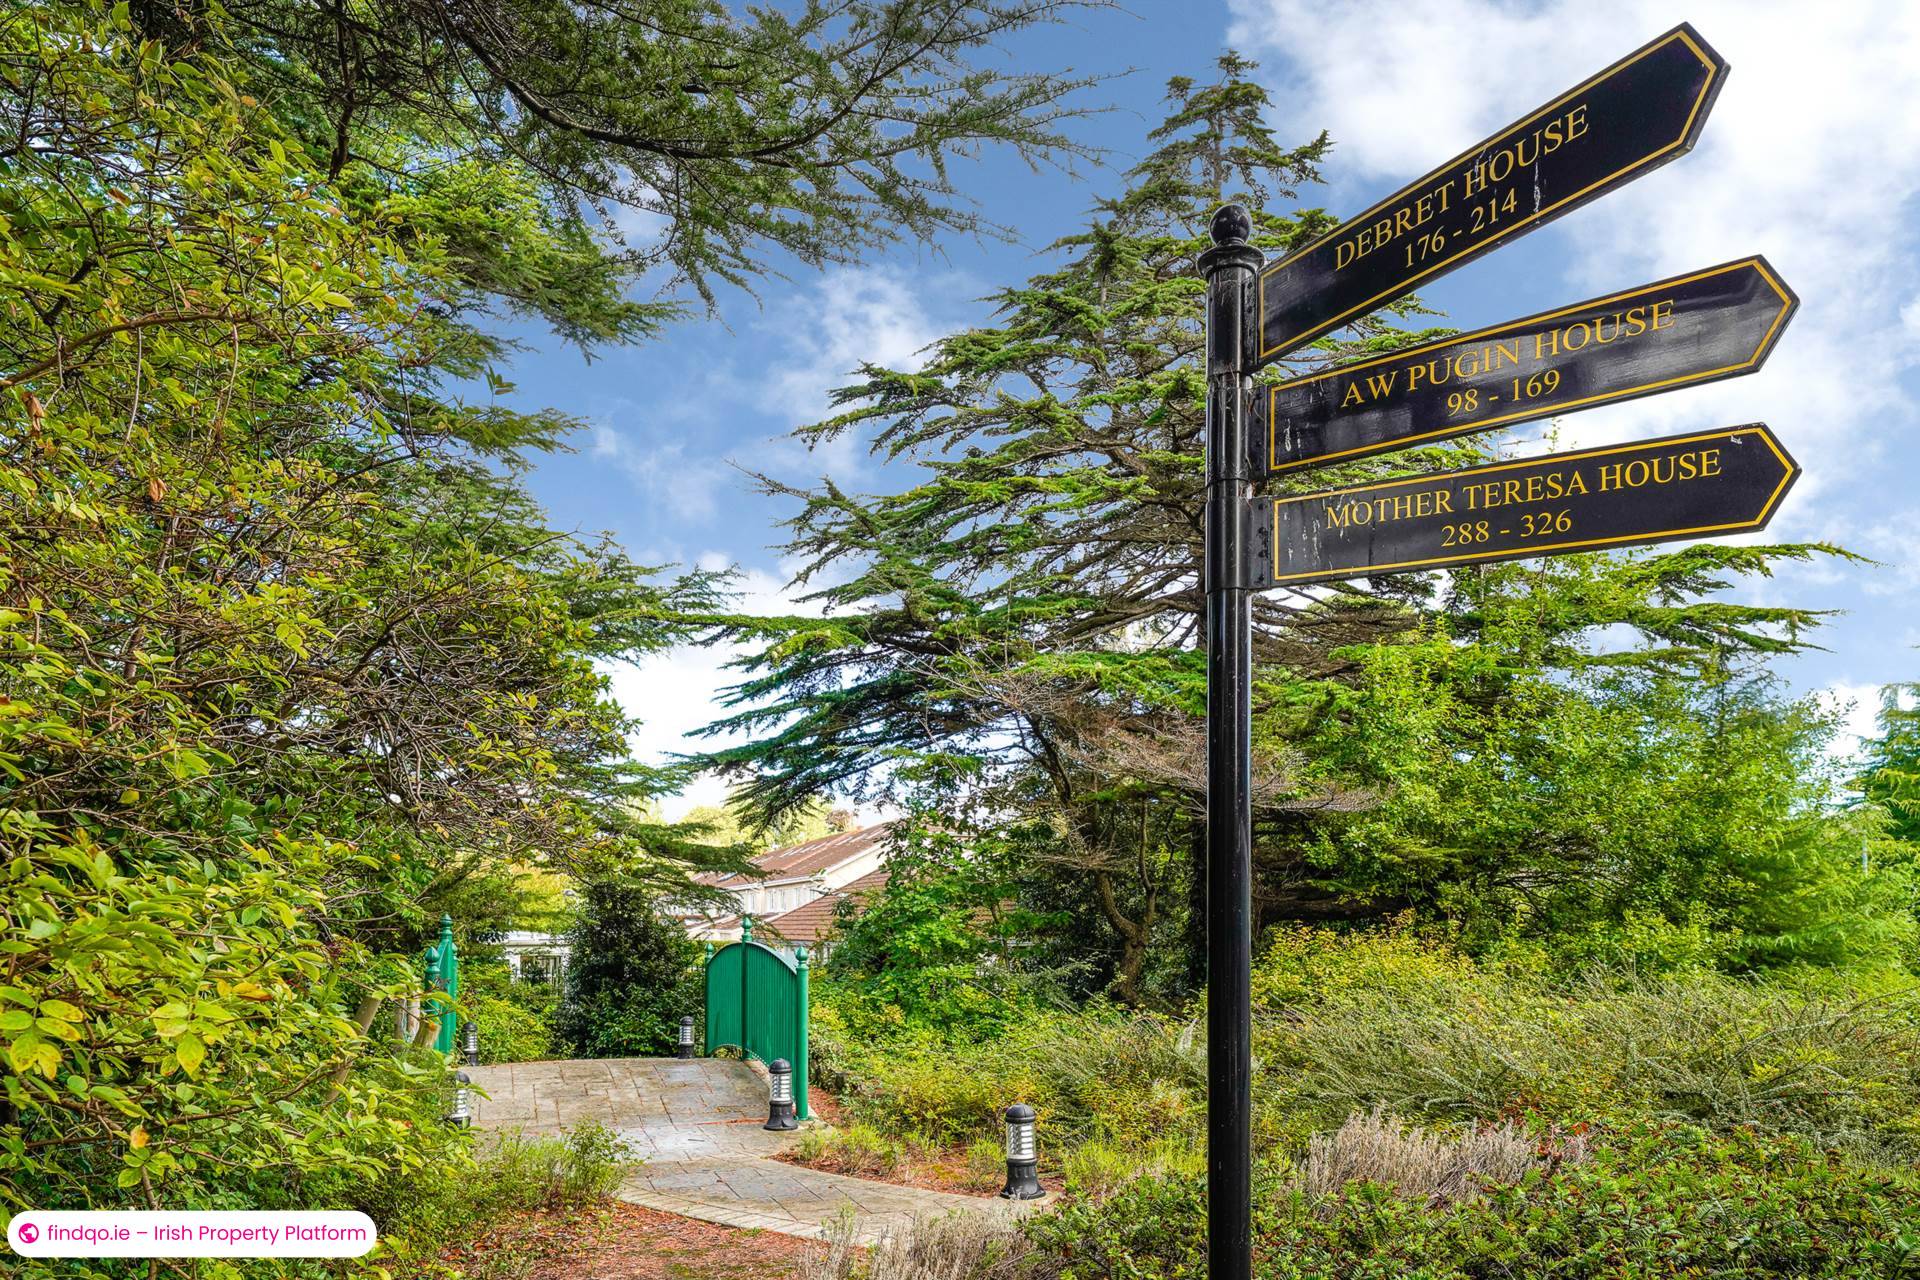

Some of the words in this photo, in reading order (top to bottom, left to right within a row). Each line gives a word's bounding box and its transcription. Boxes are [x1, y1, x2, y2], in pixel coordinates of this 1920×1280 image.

[1335, 181, 1454, 271] DEBRET
[1463, 104, 1589, 200] HOUSE
[1406, 225, 1445, 268] 176
[1471, 188, 1518, 235] 214
[1408, 340, 1520, 392] PUGIN
[1534, 299, 1676, 360] HOUSE
[1447, 389, 1478, 418] 98
[1512, 370, 1560, 402] 169
[1326, 490, 1454, 529] MOTHER
[1462, 471, 1588, 510] TERESA
[1598, 449, 1722, 492] HOUSE
[1441, 521, 1490, 547] 288
[1519, 511, 1572, 538] 326
